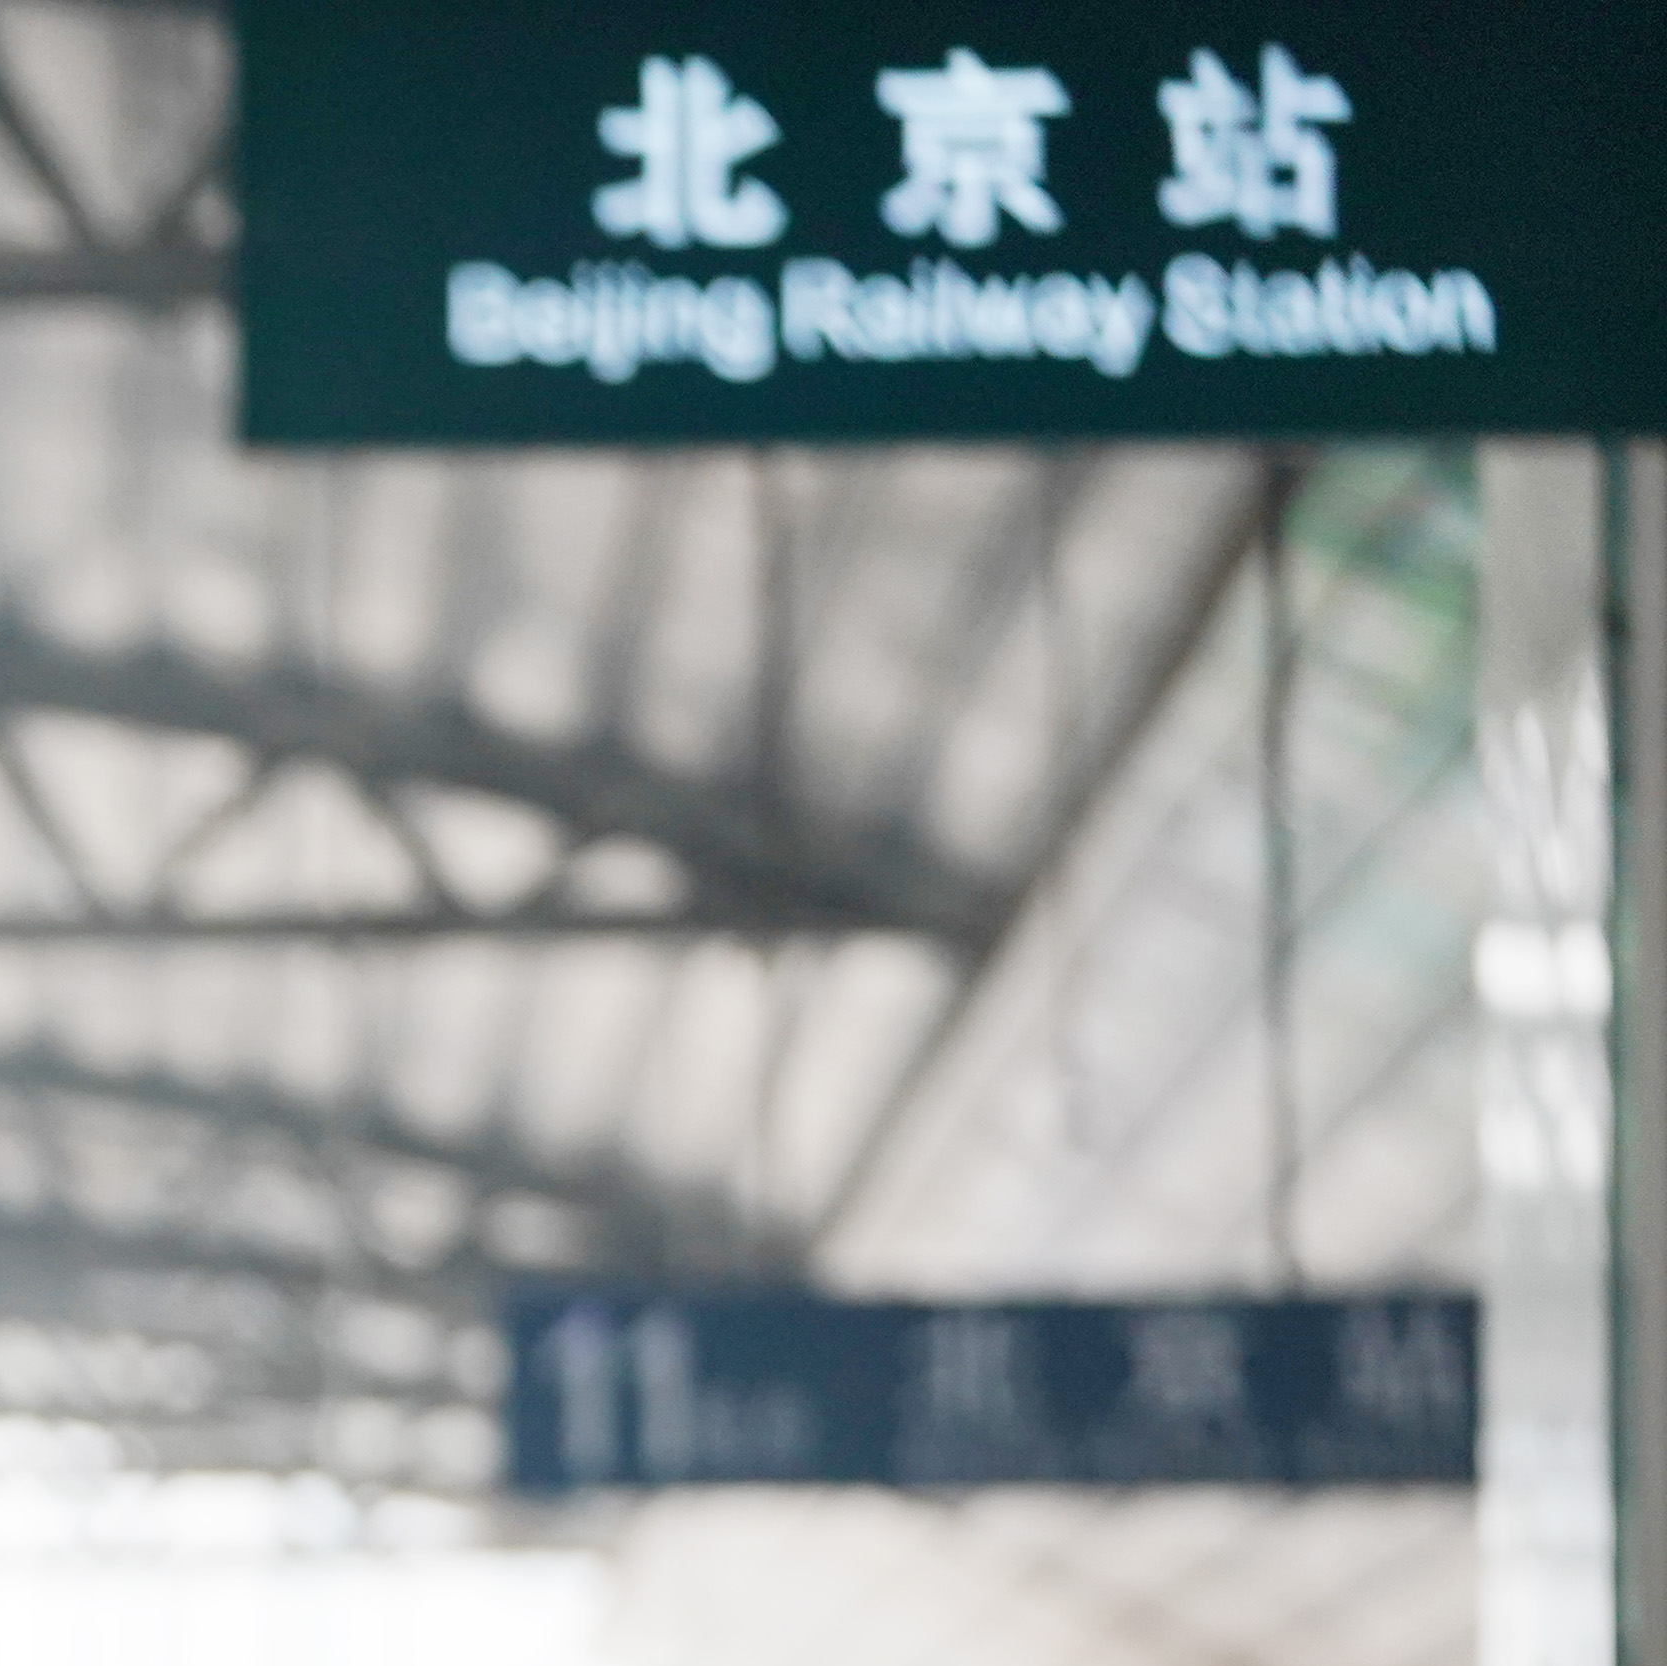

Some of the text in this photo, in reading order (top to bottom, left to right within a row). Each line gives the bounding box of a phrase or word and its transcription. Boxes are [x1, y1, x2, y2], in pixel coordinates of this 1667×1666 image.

[594, 47, 1349, 246] 北京站
[448, 255, 1494, 380] Beijing Railway Station
